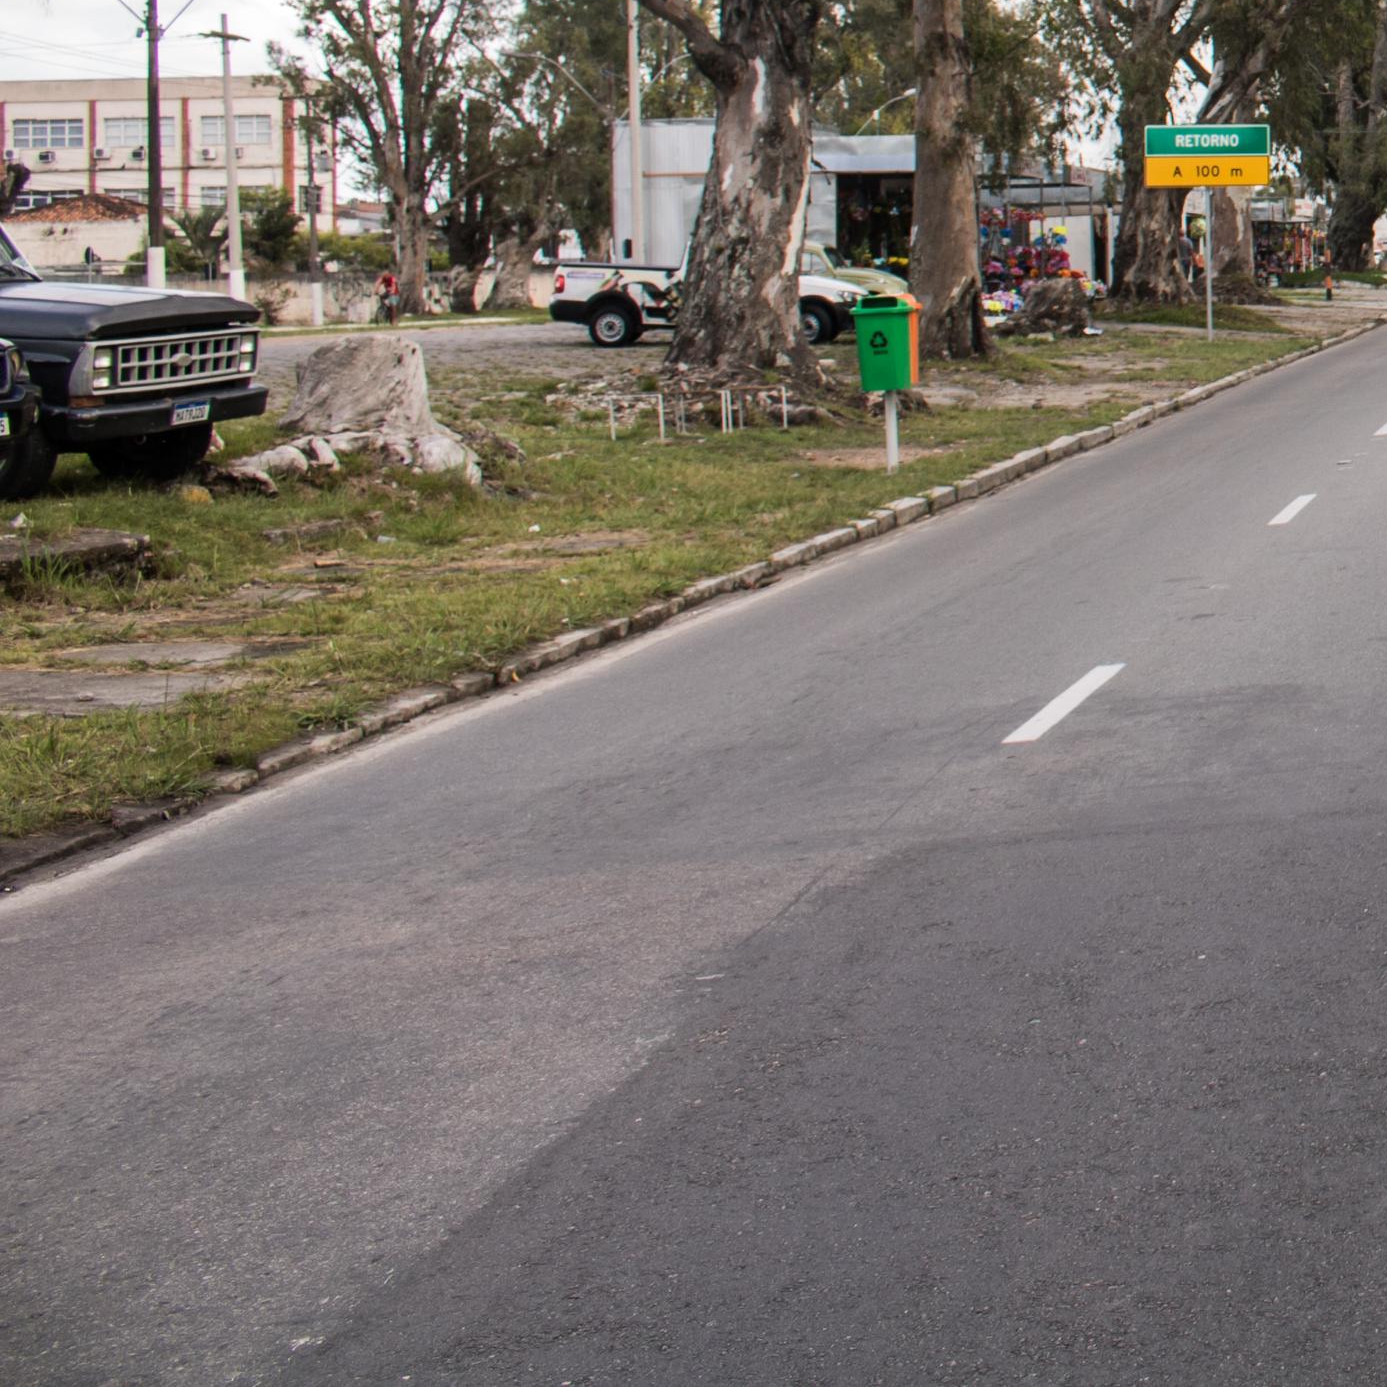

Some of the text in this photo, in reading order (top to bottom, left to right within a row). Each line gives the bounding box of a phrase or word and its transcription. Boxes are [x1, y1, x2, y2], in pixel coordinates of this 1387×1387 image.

[1175, 134, 1239, 148] RETORNO
[1173, 165, 1243, 177] A 100 m
